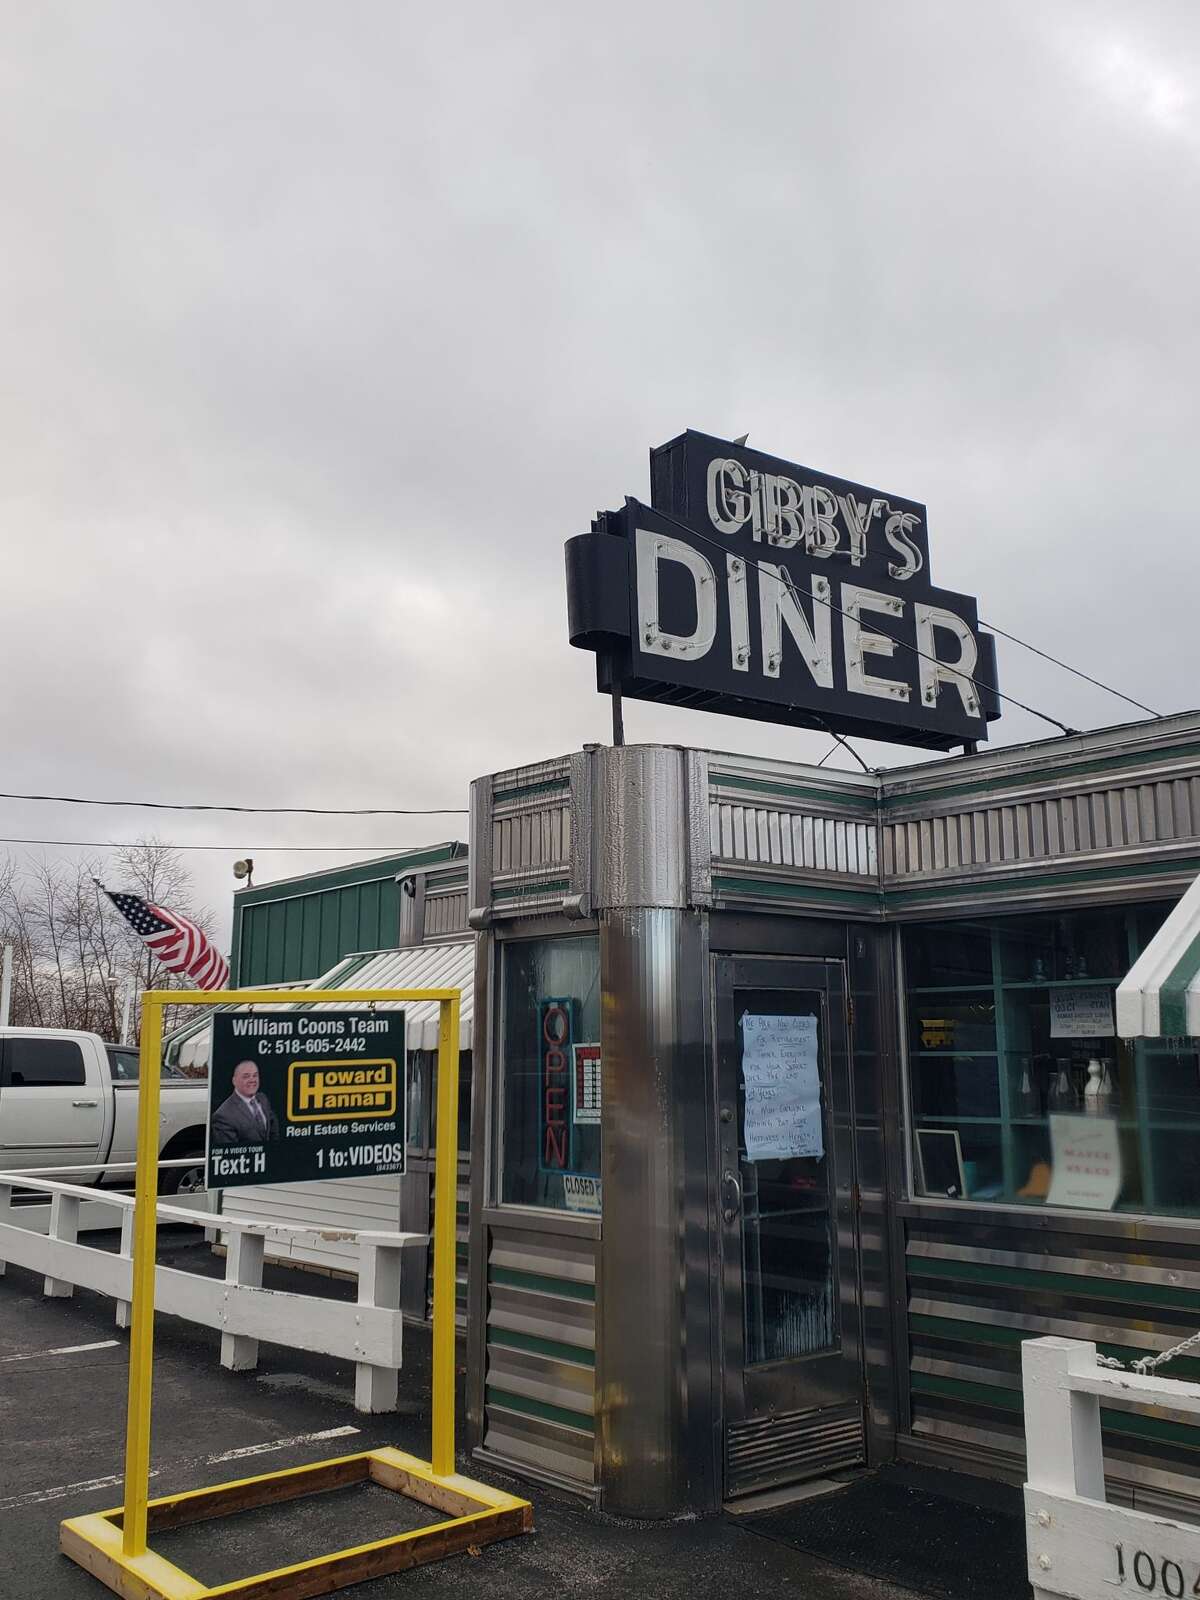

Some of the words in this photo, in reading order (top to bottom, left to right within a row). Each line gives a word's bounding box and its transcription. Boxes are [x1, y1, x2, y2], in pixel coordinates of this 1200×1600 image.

[706, 457, 922, 580] GIBBY'S
[635, 527, 980, 718] DINER
[232, 1018, 293, 1036] William
[298, 1018, 345, 1034] Coons
[349, 1017, 389, 1033] Team
[258, 1039, 272, 1054] C:
[275, 1037, 366, 1054] 518-605-2442
[300, 1066, 386, 1092] Howard
[543, 1007, 568, 1167] OPEN
[286, 1125, 311, 1136] Real
[314, 1124, 348, 1135] Estate
[351, 1121, 396, 1133] Services
[211, 1151, 250, 1176] Text:
[254, 1152, 266, 1173] H
[316, 1148, 324, 1169] 1
[230, 1146, 247, 1154] VIDEO
[248, 1145, 264, 1153] TOUR
[565, 1176, 595, 1196] CLOSED
[1114, 1541, 1200, 1599] 100
